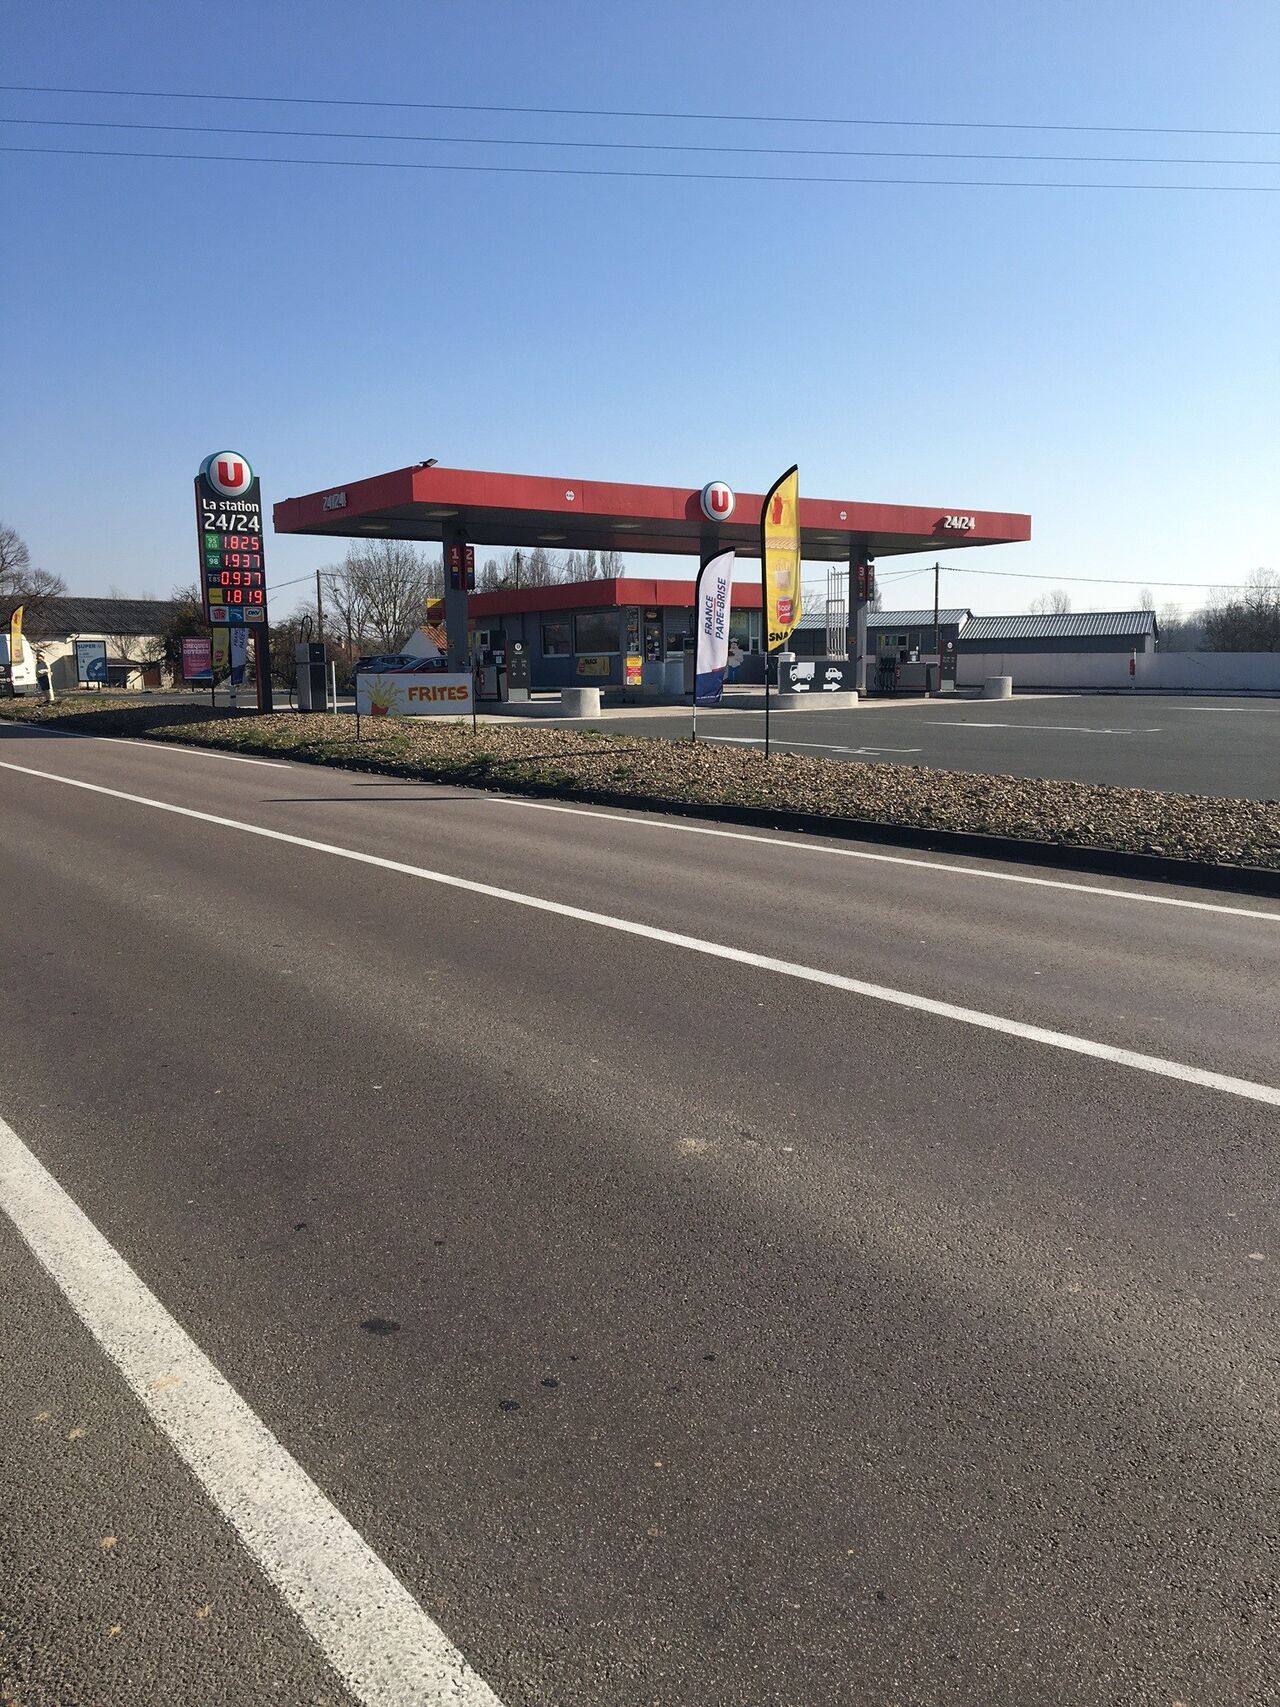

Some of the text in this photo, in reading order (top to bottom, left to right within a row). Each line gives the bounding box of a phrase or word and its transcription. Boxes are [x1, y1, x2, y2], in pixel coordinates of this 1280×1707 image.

[217, 461, 244, 488] U
[202, 498, 260, 513] La station
[711, 490, 729, 513] U
[203, 512, 260, 532] 24/24
[943, 515, 976, 530] 24/24
[224, 535, 259, 550] 1.825
[208, 557, 219, 565] 98
[225, 554, 260, 567] 1.937
[451, 547, 459, 560] 1
[465, 548, 473, 560] 2
[221, 571, 261, 586] 0.937
[859, 566, 865, 577] 3
[867, 566, 874, 577] 4
[227, 589, 262, 604] 1.819
[704, 594, 714, 636] FRANCE
[715, 576, 727, 640] PARE-BRISE
[407, 685, 470, 702] FRITES
